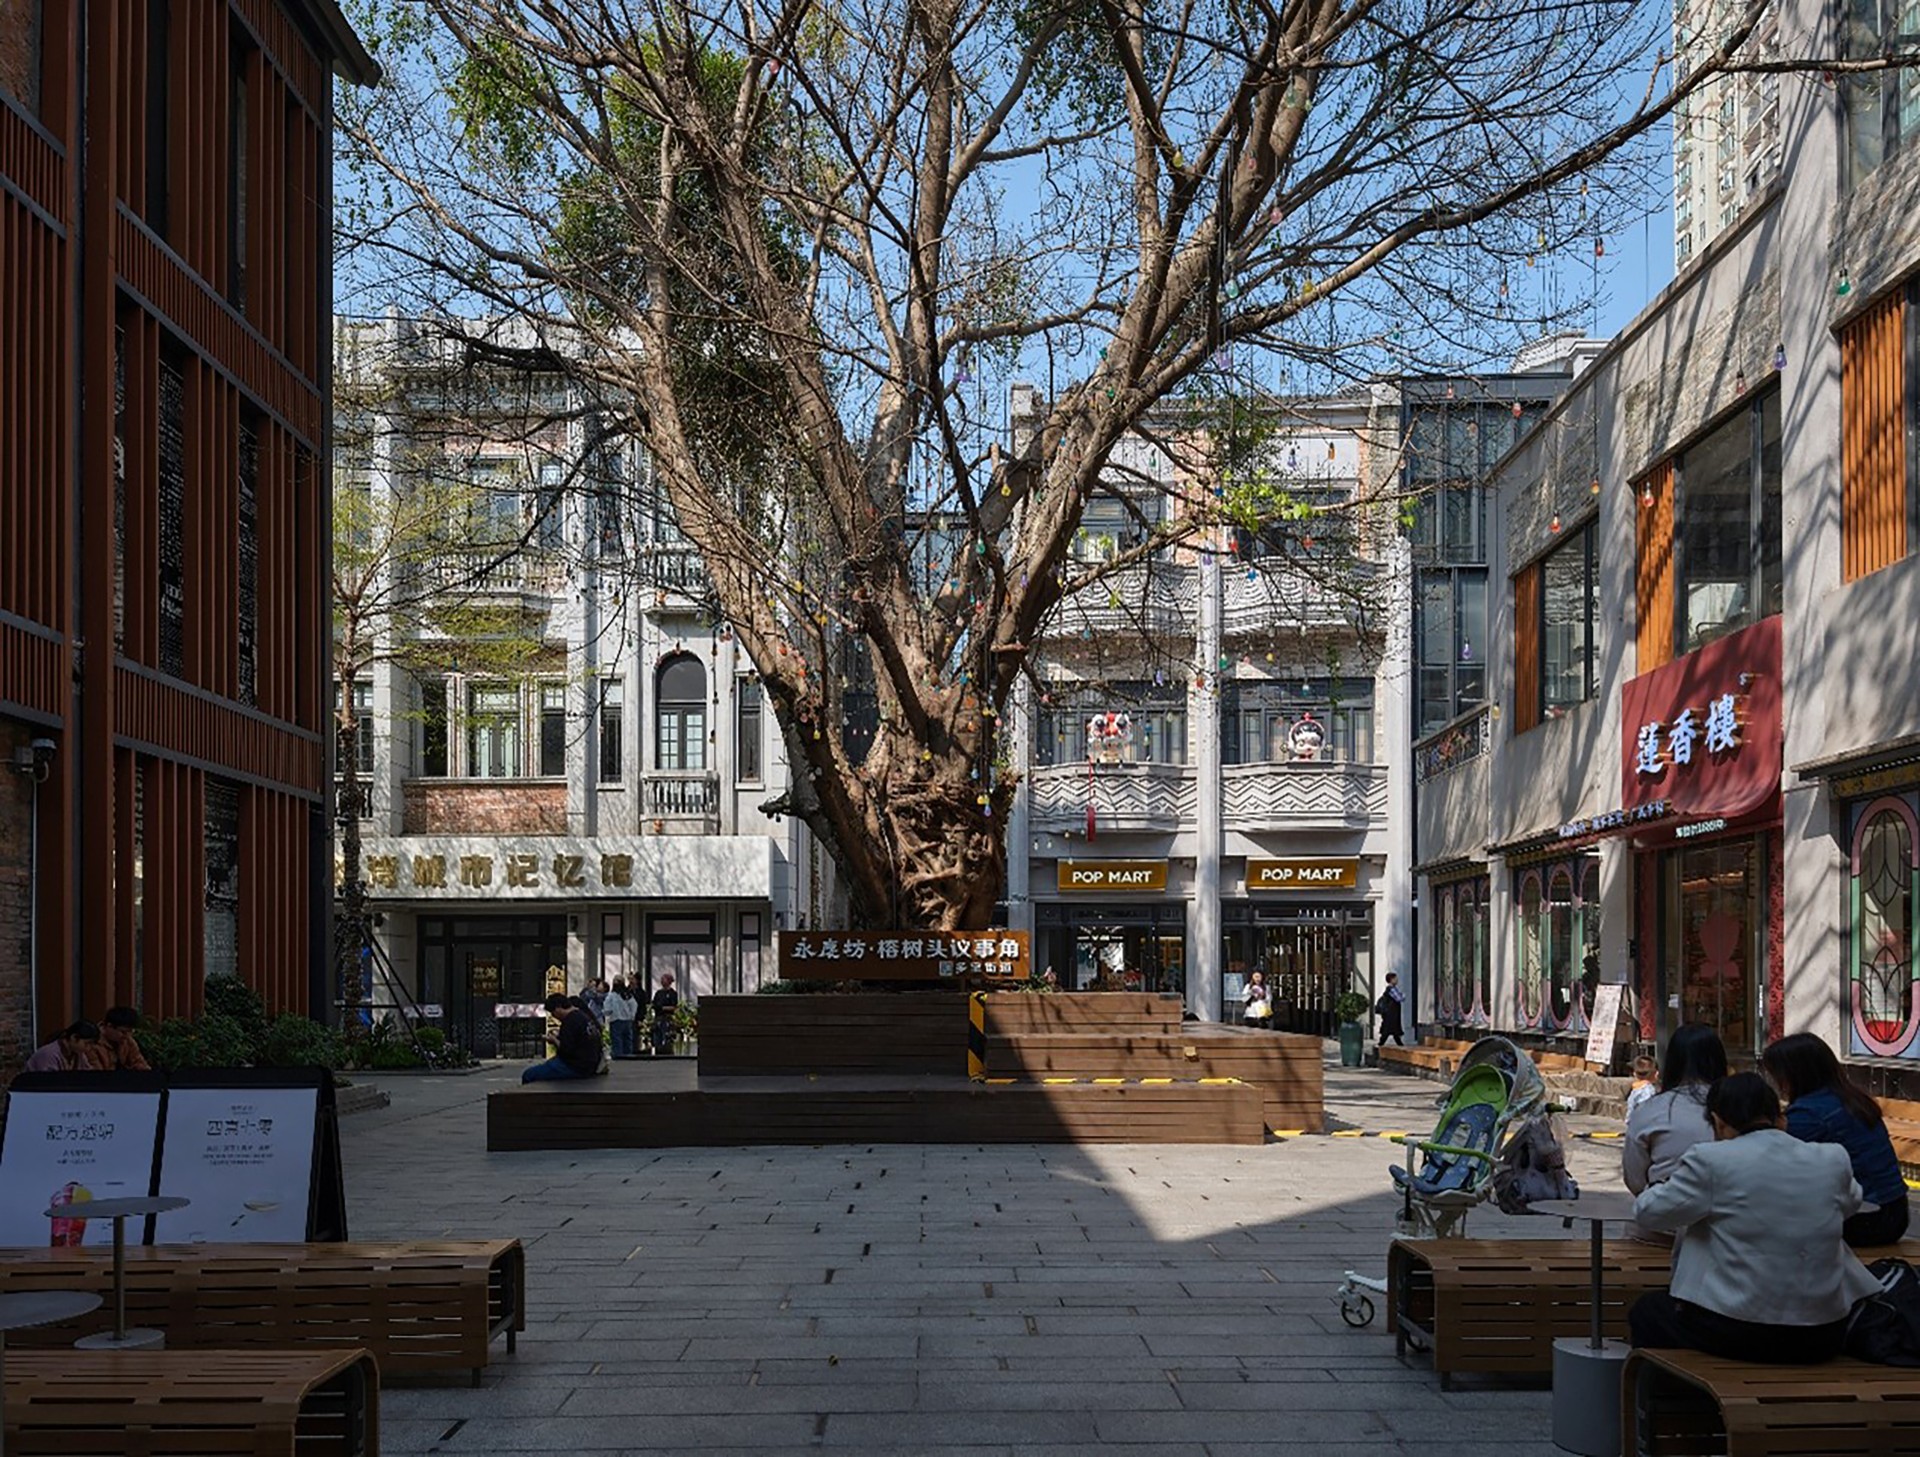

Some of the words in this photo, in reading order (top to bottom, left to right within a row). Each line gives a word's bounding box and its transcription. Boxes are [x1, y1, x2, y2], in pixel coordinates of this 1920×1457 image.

[1634, 693, 1738, 775] 蓮香樓
[1072, 870, 1104, 883] POP
[1108, 870, 1152, 883] MART
[1261, 868, 1293, 881] POP
[1298, 868, 1343, 881] MART
